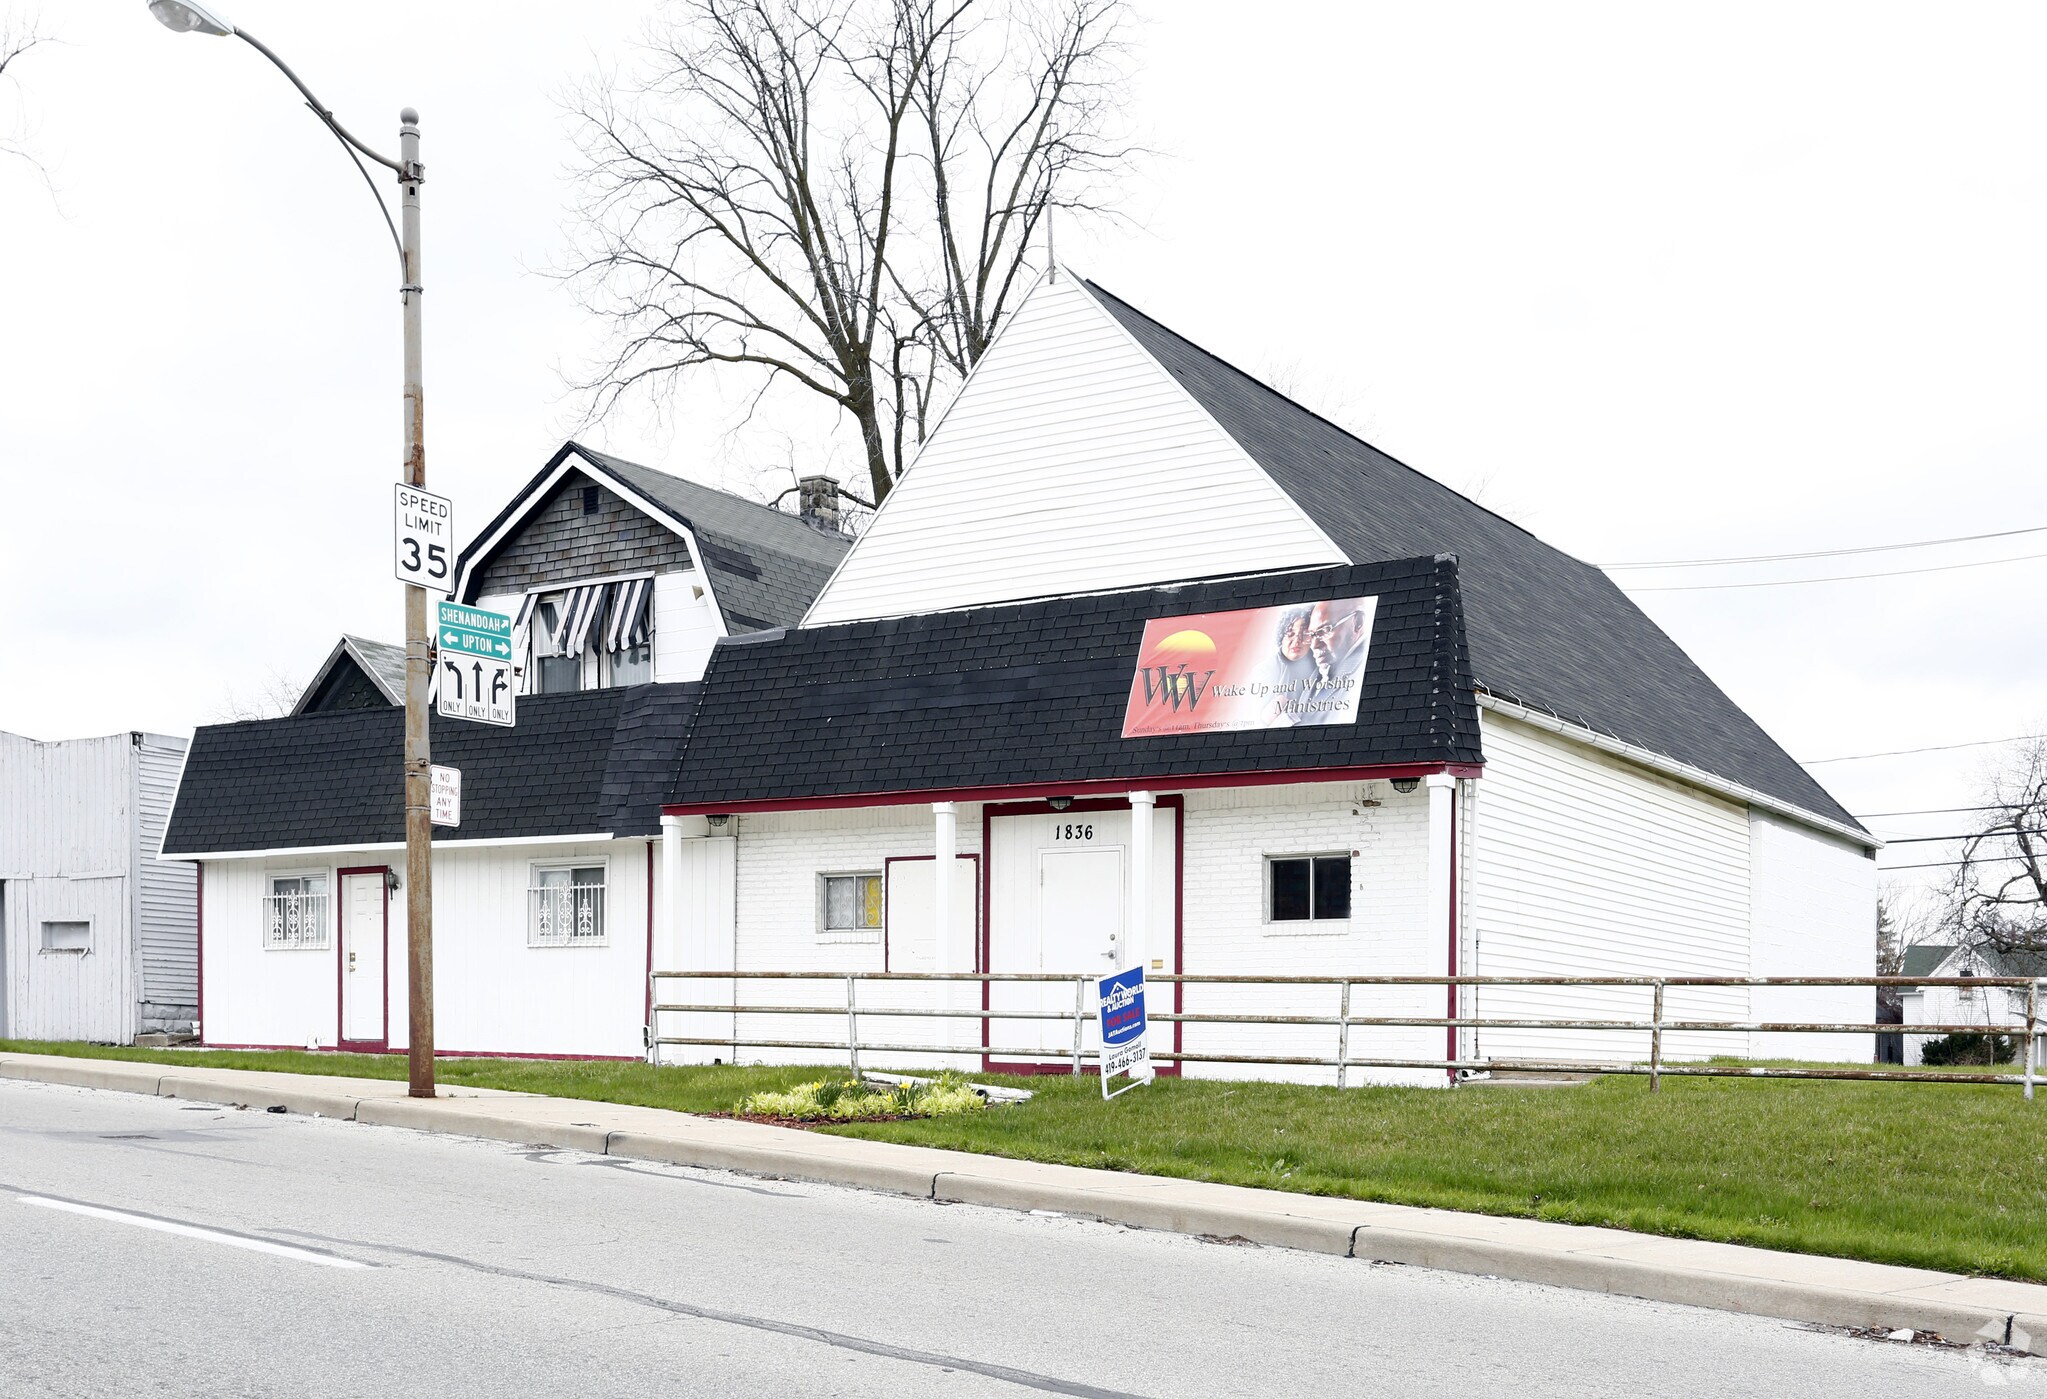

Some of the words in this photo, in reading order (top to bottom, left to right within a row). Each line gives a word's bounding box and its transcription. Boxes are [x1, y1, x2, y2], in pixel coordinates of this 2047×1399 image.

[400, 492, 448, 518] SPEED
[405, 512, 442, 536] LIMIT
[401, 537, 448, 579] 35
[441, 607, 501, 632] SHENANDOAH
[462, 634, 493, 653] UPTON
[1211, 681, 1246, 698] Wake
[1250, 681, 1269, 698] Up
[1272, 679, 1296, 694] and
[1301, 675, 1355, 694] Worship
[443, 700, 461, 714] ONLY
[468, 705, 486, 719] ONLY
[492, 707, 509, 721] ONLY
[1273, 696, 1351, 715] Ministries
[439, 772, 451, 783] NO
[431, 783, 458, 797] STOPPING
[436, 796, 452, 808] ANY
[435, 808, 452, 820] TIME
[1055, 824, 1093, 840] 1836
[1100, 991, 1121, 1007] REALTY
[1121, 983, 1144, 999] WORLD
[1111, 996, 1135, 1011] AUCTION
[1106, 1014, 1121, 1029] FOR
[1123, 1007, 1141, 1022] SALE
[1105, 1047, 1146, 1075] 419-466-3137
